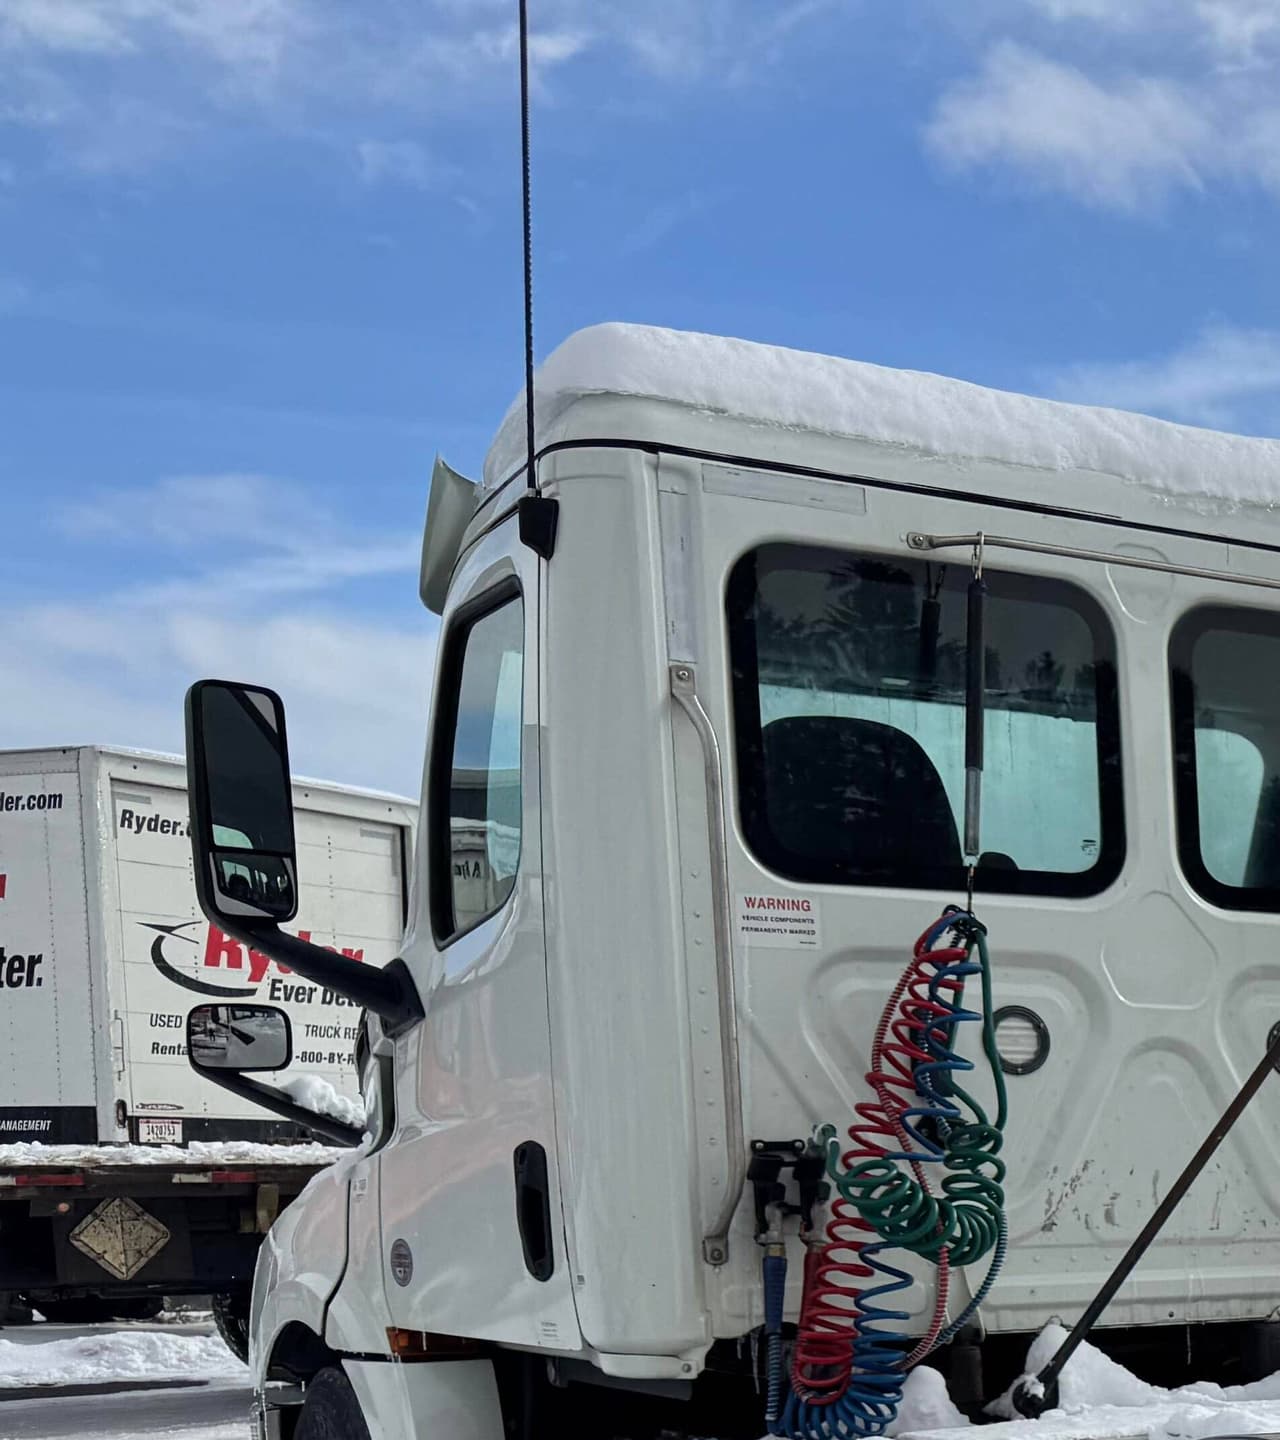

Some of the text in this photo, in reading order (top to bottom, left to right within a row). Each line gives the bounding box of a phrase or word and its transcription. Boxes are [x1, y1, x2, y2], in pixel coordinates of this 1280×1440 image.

[744, 896, 811, 912] WARNING
[269, 979, 317, 1005] Ever
[150, 1013, 183, 1028] USED
[304, 1024, 341, 1039] TRUCK
[151, 1041, 189, 1056] Renta
[0, 1119, 52, 1131] ANAGEMENT
